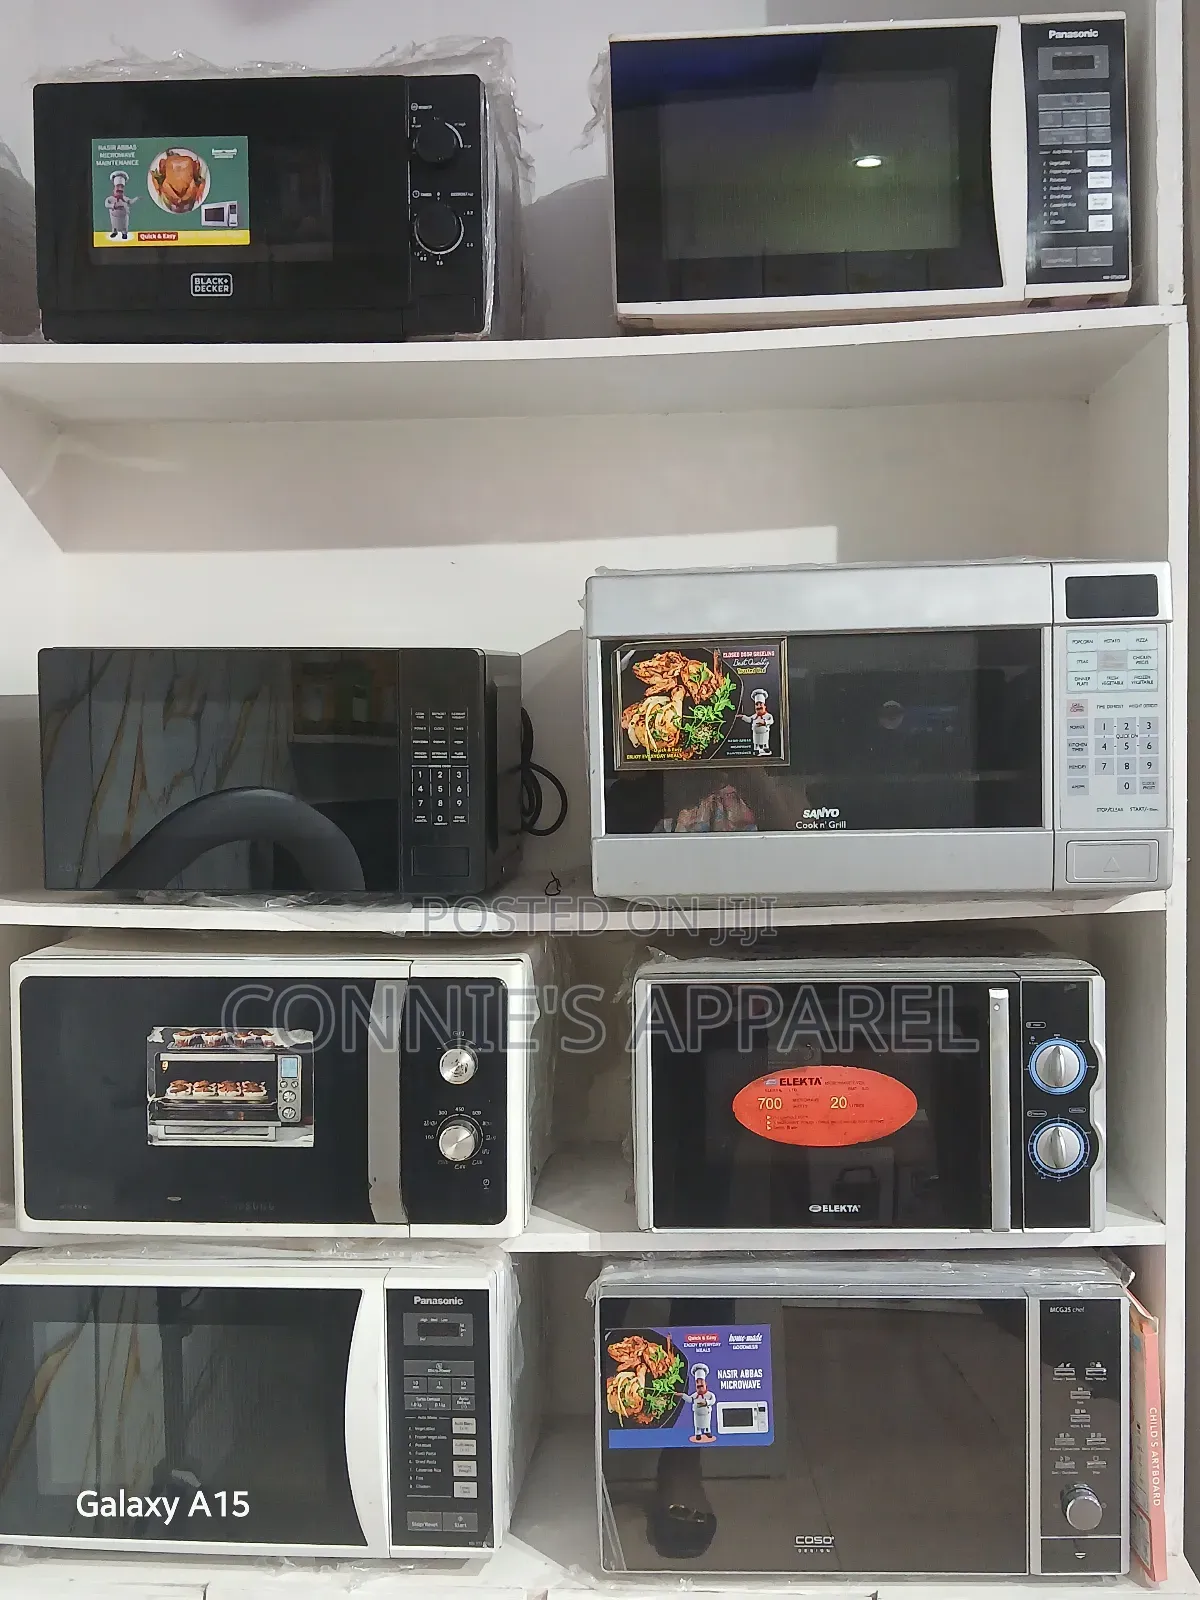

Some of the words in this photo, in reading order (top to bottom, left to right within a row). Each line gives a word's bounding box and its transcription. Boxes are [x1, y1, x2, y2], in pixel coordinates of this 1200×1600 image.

[1048, 29, 1099, 39] Panasonic
[1146, 722, 1152, 730] 3
[1102, 743, 1107, 751] 4
[1124, 742, 1130, 750] 5
[1146, 742, 1152, 750] 6
[1124, 782, 1130, 790] 0
[803, 807, 840, 819] SANYO
[796, 821, 818, 829] Cook
[780, 1077, 822, 1086] ELEKTA
[757, 1096, 782, 1110] 700
[830, 1095, 848, 1109] 20
[414, 1296, 463, 1305] Panasonic
[718, 1370, 738, 1379] NASIR
[740, 1369, 763, 1378] ABBAS
[720, 1380, 761, 1389] MICROWAVE
[1149, 1407, 1159, 1447] CHILD'S
[1151, 1451, 1161, 1506] ARTBOARD
